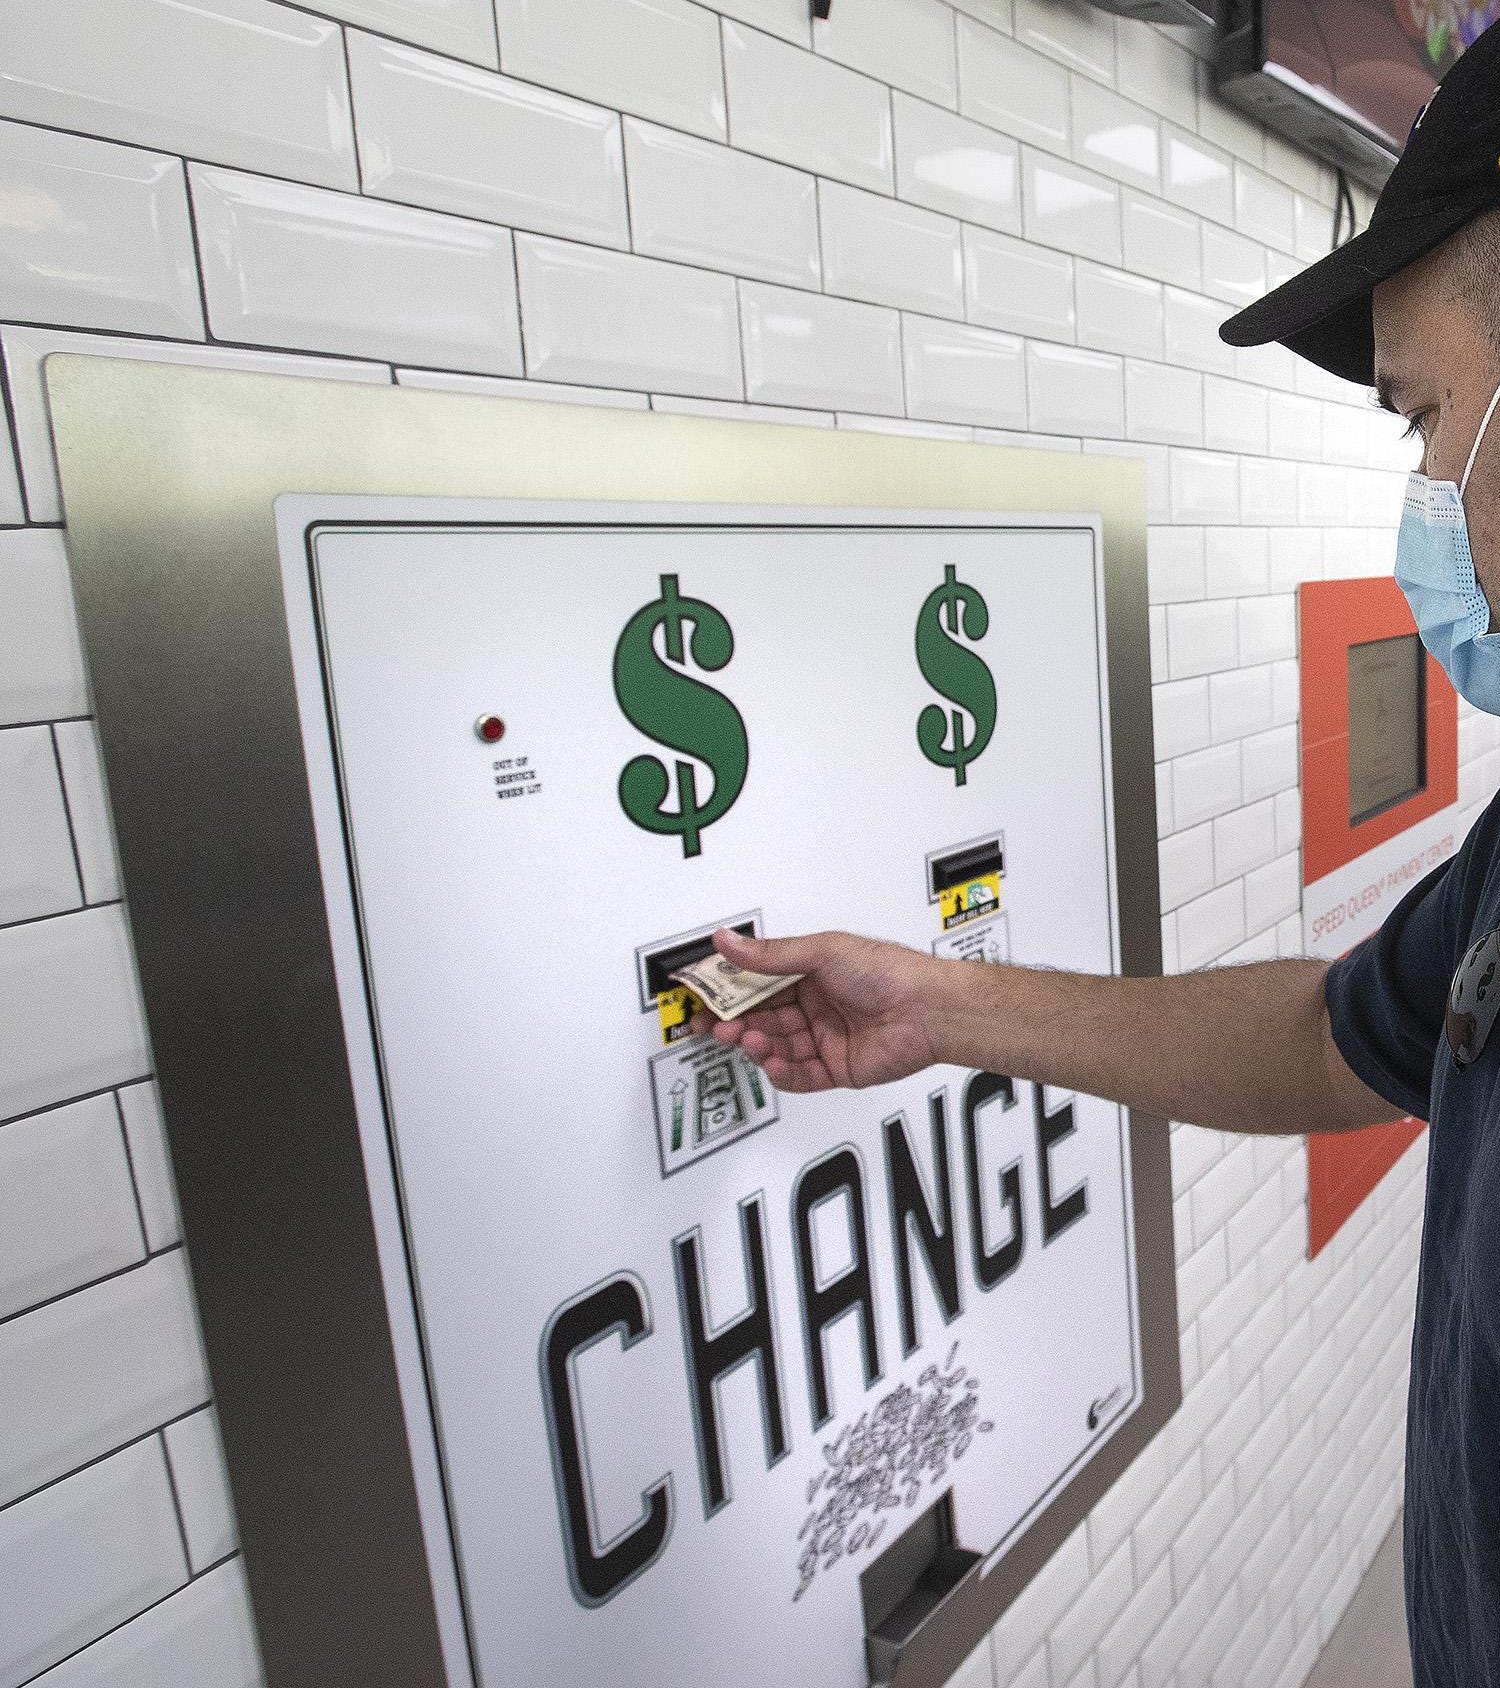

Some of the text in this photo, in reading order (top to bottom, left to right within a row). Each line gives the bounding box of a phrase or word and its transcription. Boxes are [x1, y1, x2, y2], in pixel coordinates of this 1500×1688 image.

[493, 756, 528, 770] OUT OF
[496, 770, 536, 785] SERVICE
[497, 783, 542, 799] WHEN LIT
[1311, 902, 1345, 942] SPEED
[538, 1071, 1089, 1610] CHANGE
